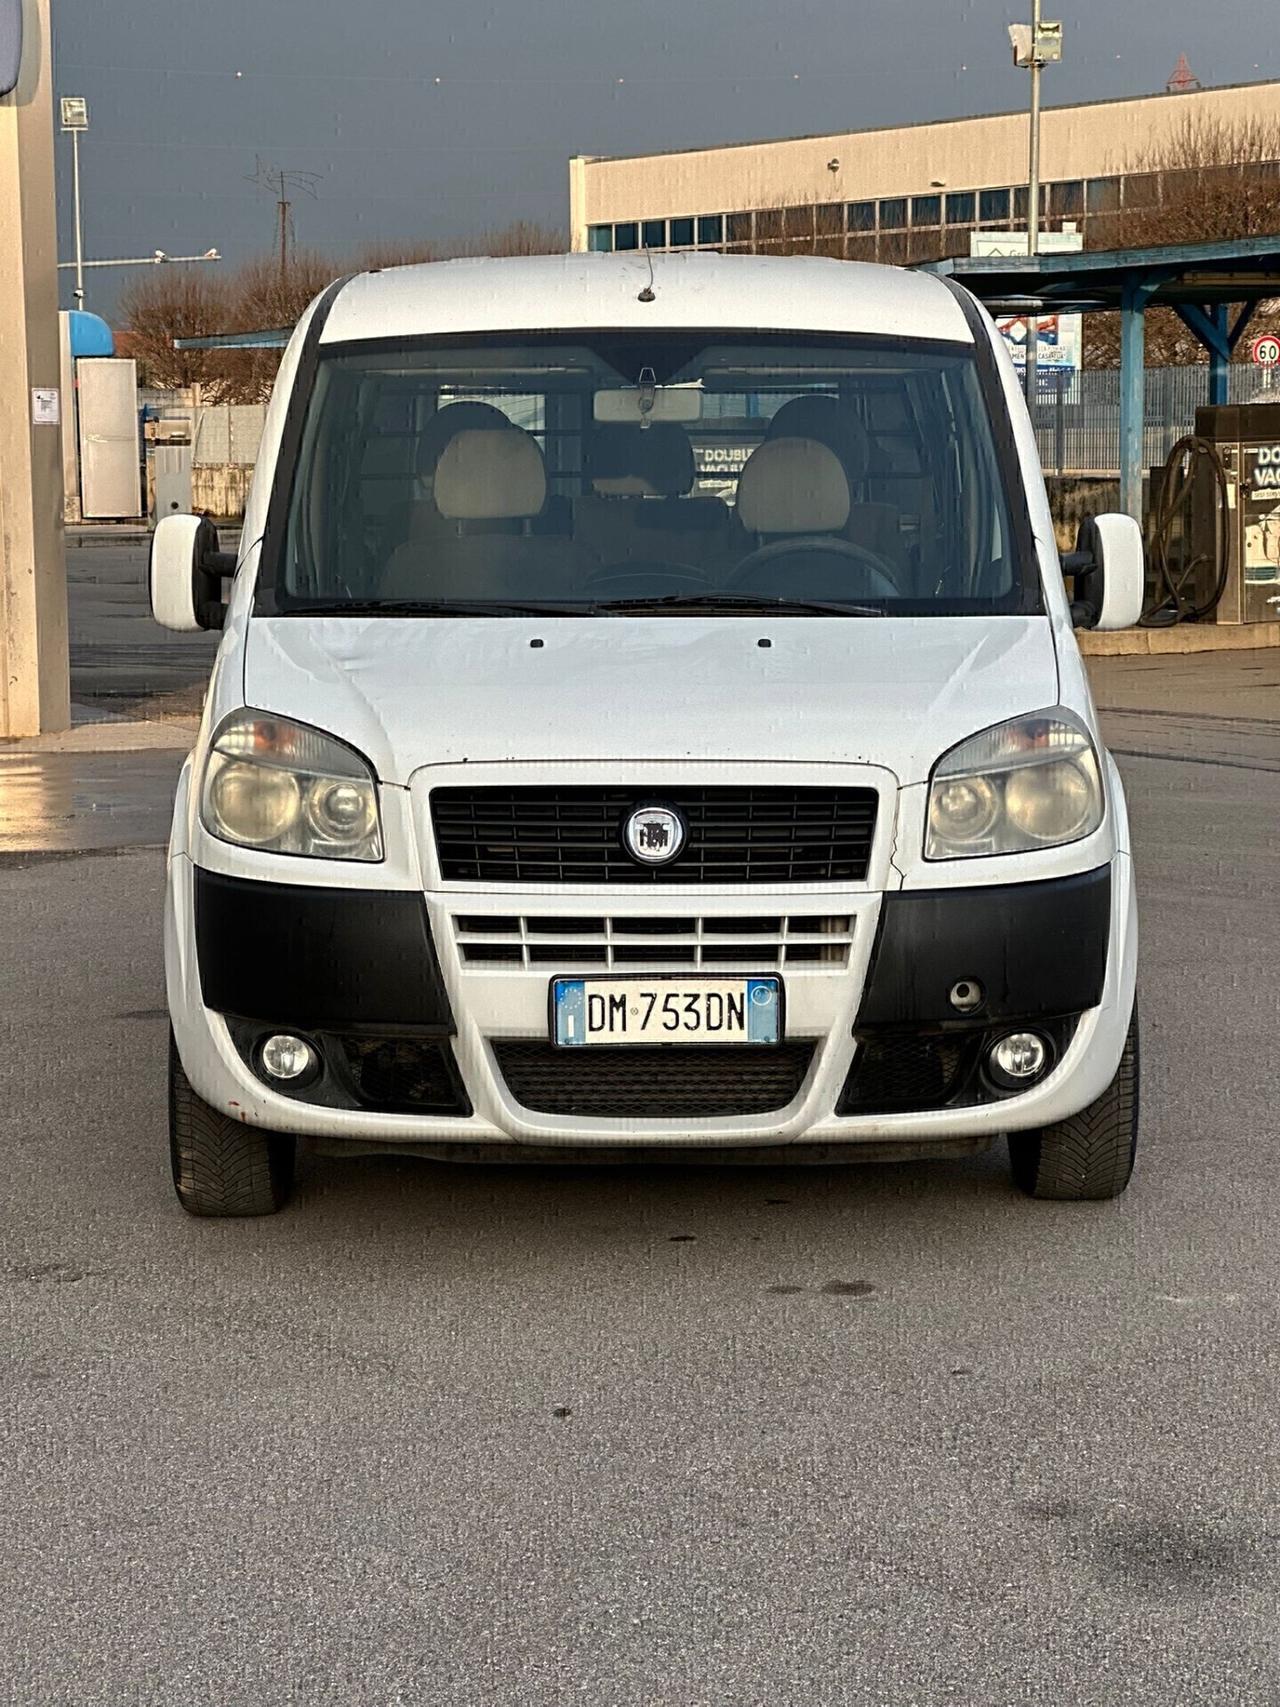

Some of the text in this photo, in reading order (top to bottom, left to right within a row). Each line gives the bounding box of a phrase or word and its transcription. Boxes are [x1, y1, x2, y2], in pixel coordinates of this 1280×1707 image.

[1259, 345, 1277, 360] 60
[588, 992, 745, 1032] DM 753DN
